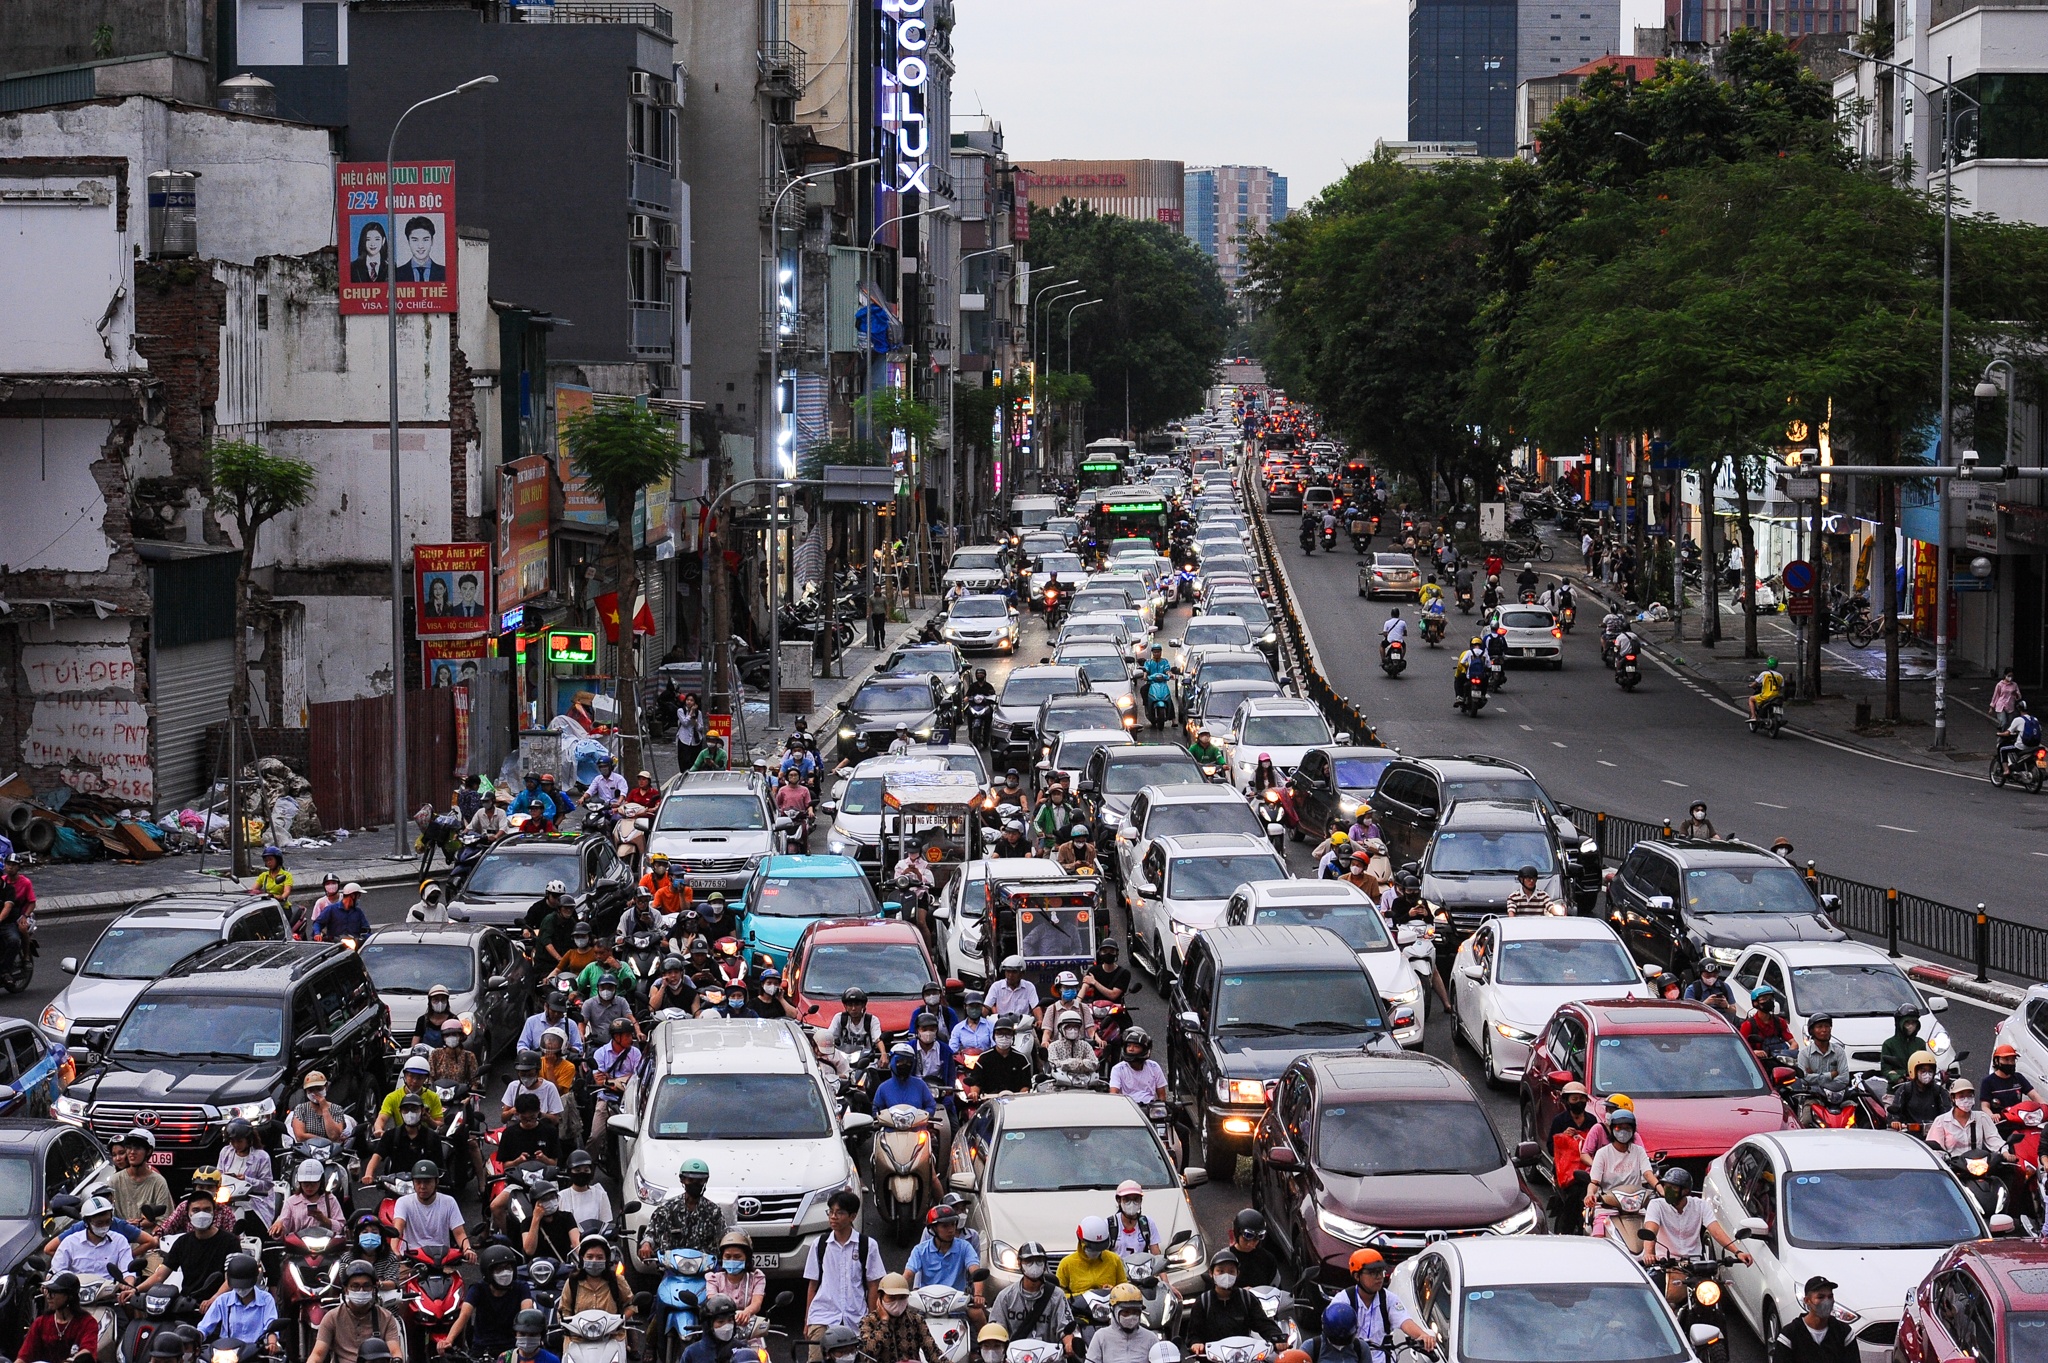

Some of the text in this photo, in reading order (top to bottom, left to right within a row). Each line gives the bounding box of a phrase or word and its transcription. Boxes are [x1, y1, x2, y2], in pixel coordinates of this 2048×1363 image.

[341, 169, 363, 188] HIỆU
[365, 168, 387, 186] ẢNH
[422, 165, 452, 185] HUY
[347, 191, 378, 210] 124
[419, 192, 443, 211] BỘC
[342, 282, 448, 302] CHỤP NH THẺ
[361, 302, 383, 310] VISA
[426, 622, 442, 630] VISA
[931, 731, 944, 743] G7
